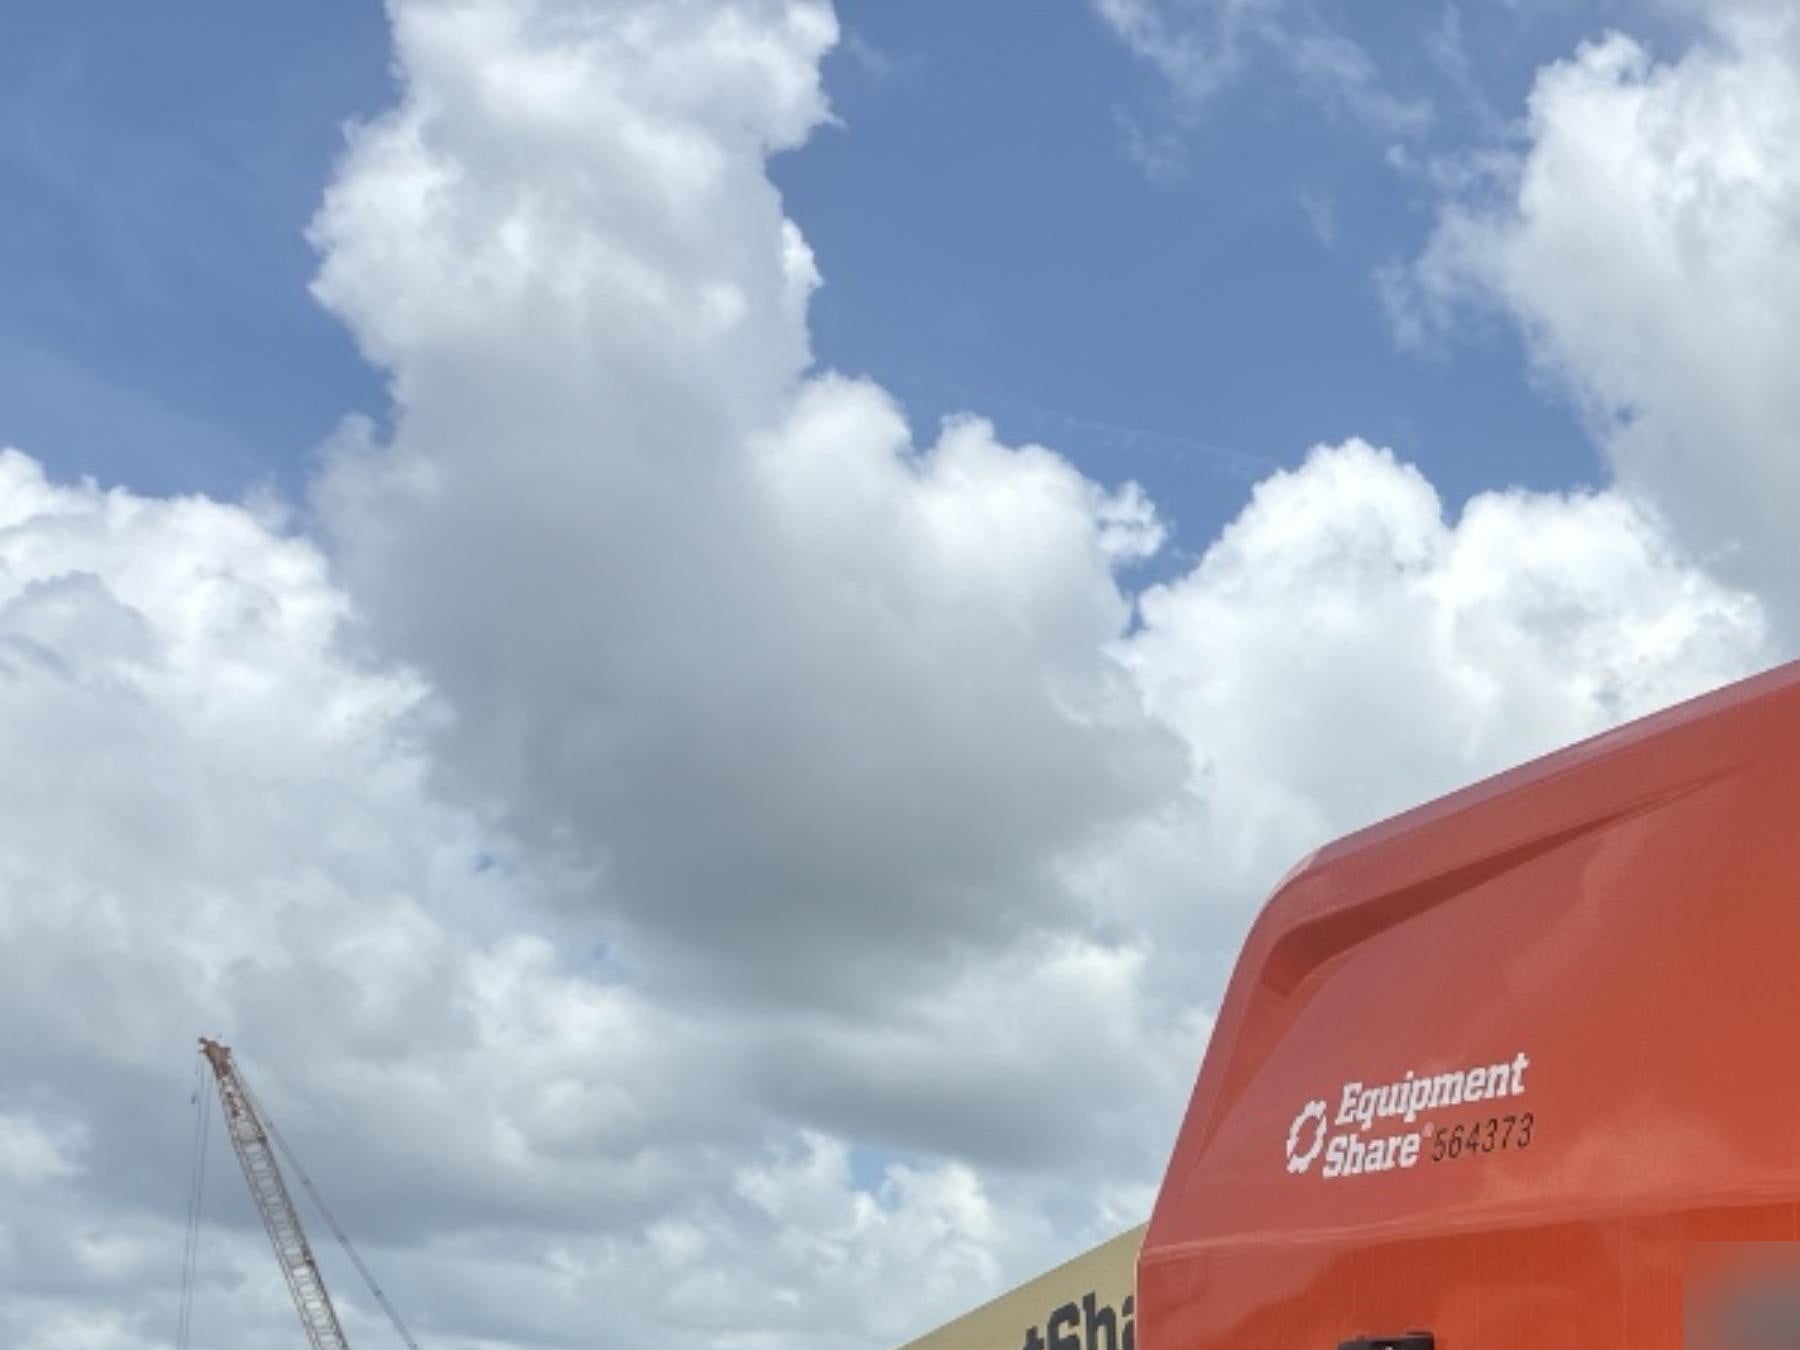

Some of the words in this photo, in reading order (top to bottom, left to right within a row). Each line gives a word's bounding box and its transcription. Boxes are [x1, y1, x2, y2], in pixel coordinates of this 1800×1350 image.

[1334, 1051, 1530, 1130] Equipment
[1322, 1131, 1420, 1179] Share
[1430, 1111, 1535, 1163] 564373
